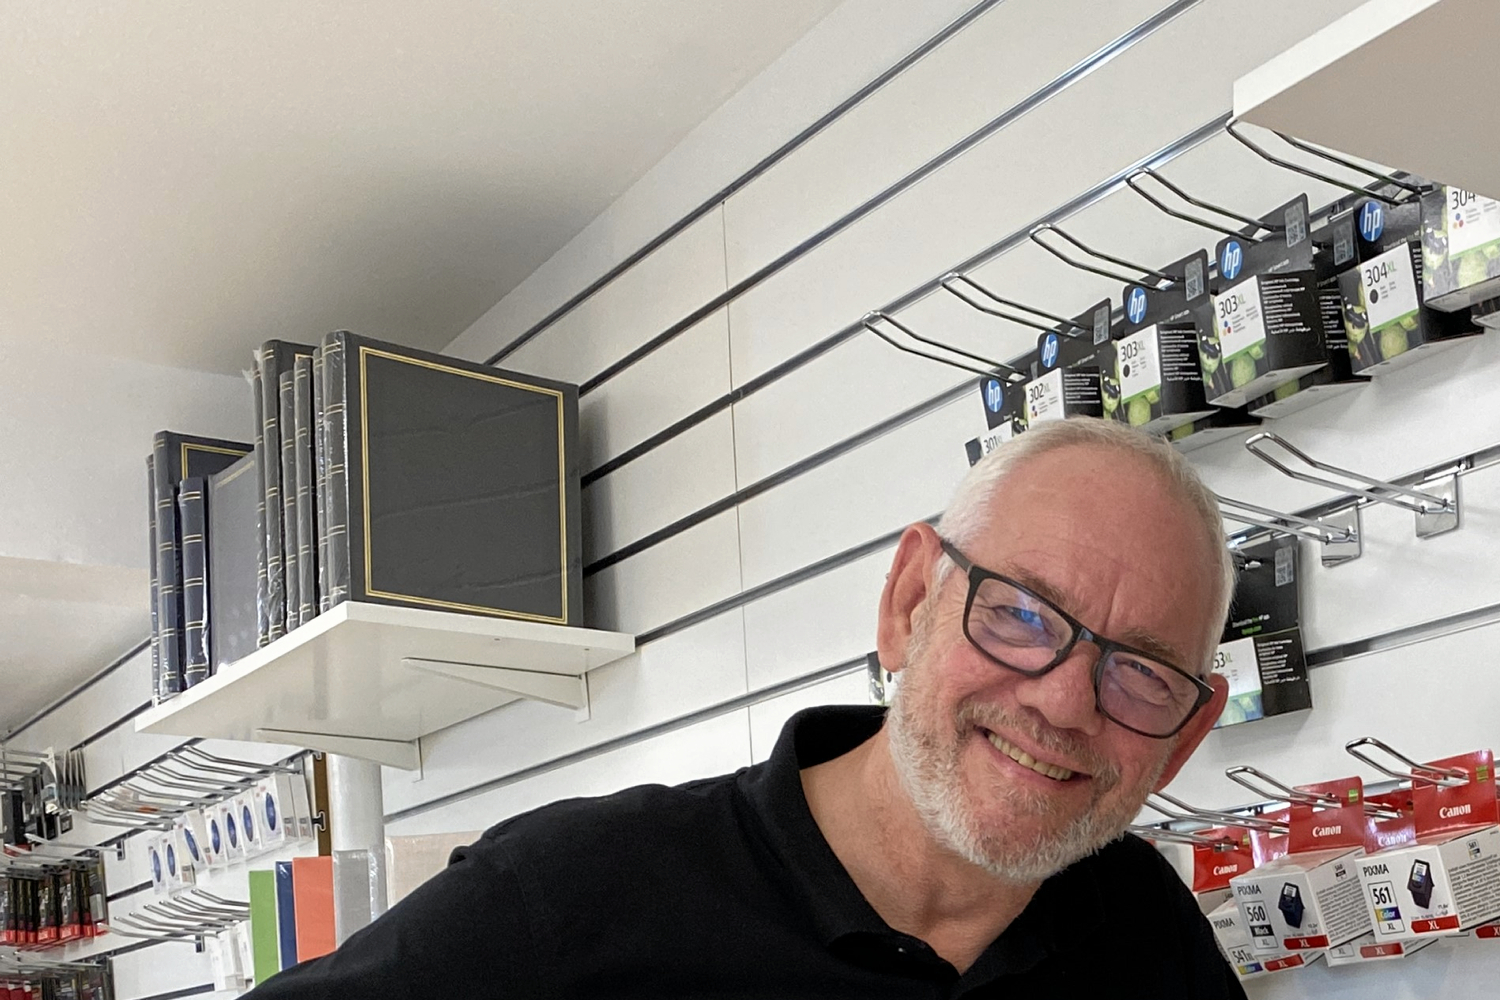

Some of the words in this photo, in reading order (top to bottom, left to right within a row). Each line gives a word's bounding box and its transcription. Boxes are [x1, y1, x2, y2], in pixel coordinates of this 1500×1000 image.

[1452, 189, 1476, 210] 304
[1363, 202, 1381, 241] hp
[1224, 242, 1240, 279] hp
[1366, 261, 1397, 287] 304XL
[1130, 288, 1145, 323] hp
[1218, 293, 1246, 318] 303XL
[1042, 333, 1058, 367] hp
[987, 380, 1002, 412] hp
[1439, 804, 1472, 818] Canon
[1312, 826, 1342, 838] Canon
[1378, 834, 1407, 847] Canon
[1213, 864, 1238, 876] Canon
[1362, 864, 1390, 878] PIXMA
[1237, 884, 1262, 896] PIXMA
[1373, 886, 1392, 905] 561
[1246, 906, 1266, 922] 560
[1381, 909, 1396, 920] Color
[1214, 918, 1236, 930] PIXMA
[1387, 922, 1396, 930] XL
[1428, 920, 1440, 930] XL
[1299, 938, 1310, 948] XL
[1376, 946, 1386, 955] XL
[1277, 960, 1288, 968] XL
